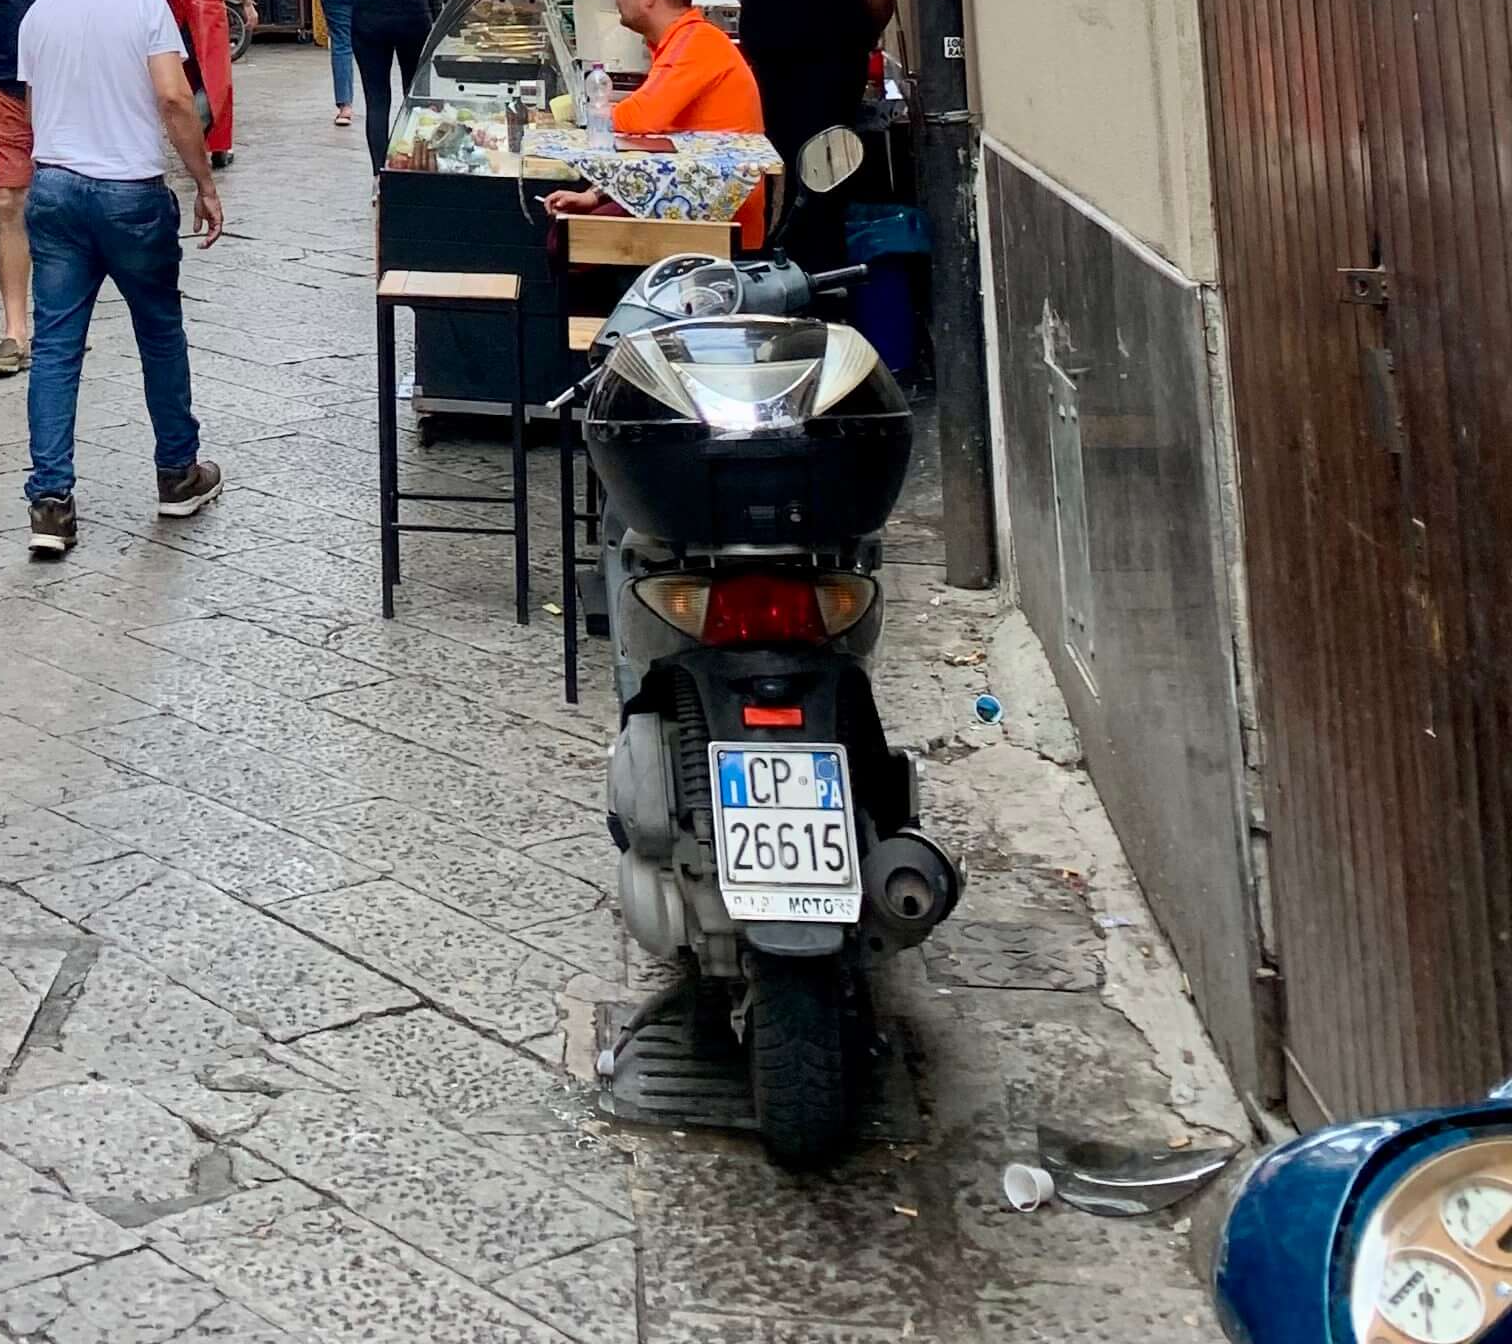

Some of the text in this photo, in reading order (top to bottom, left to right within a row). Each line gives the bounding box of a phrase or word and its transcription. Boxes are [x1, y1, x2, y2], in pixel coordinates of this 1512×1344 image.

[729, 757, 844, 809] I CP PA
[730, 821, 845, 872] 26615
